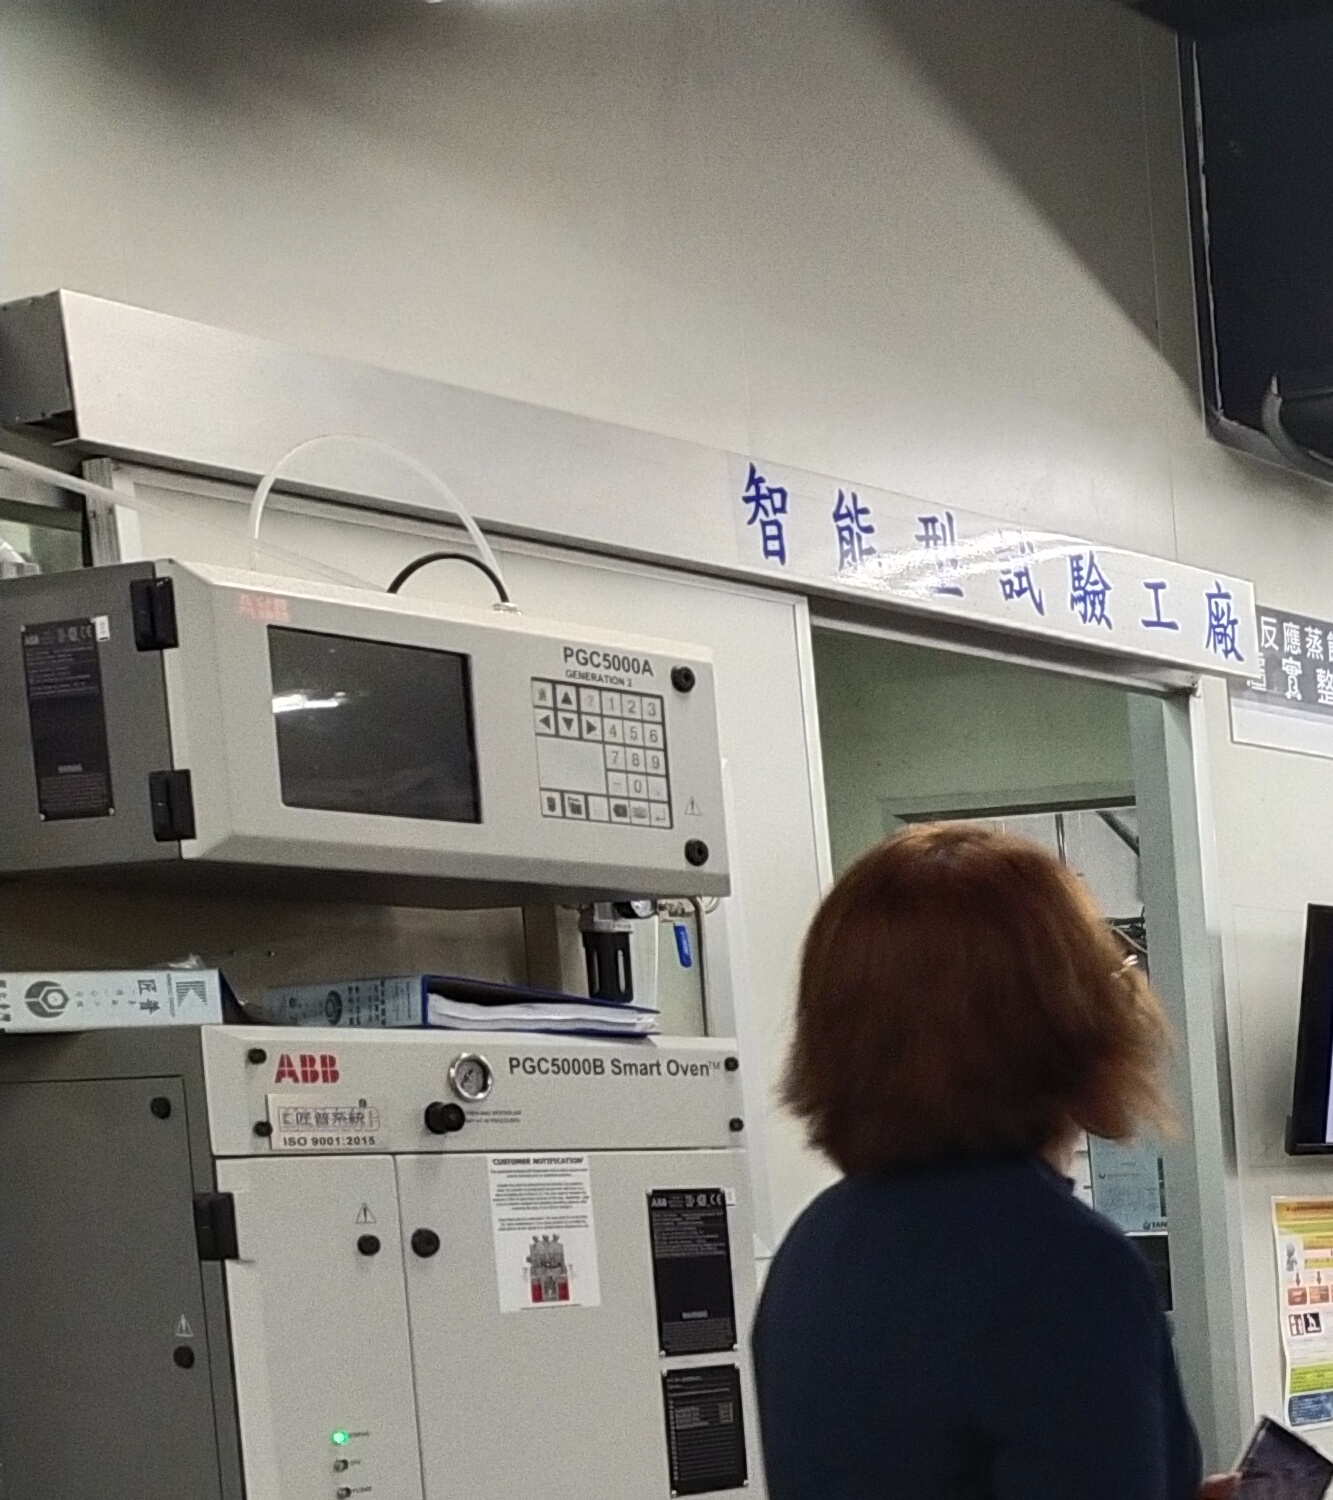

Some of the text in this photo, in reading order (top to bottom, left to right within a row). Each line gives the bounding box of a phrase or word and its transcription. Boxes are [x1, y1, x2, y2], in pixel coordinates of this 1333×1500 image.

[741, 461, 1245, 663] 智能型試驗工廠
[563, 646, 654, 677] PGC5000A
[565, 669, 633, 688] GENERATION 2
[628, 699, 636, 714] 2
[648, 702, 657, 717] 3
[609, 724, 658, 744] 4 5 6
[612, 751, 660, 769] 7 8 9
[634, 779, 642, 794] 0
[274, 1053, 340, 1084] ABB
[508, 1057, 605, 1075] PGC5000B
[611, 1058, 662, 1076] Smart
[283, 1136, 375, 1147] ISO 9001:2015
